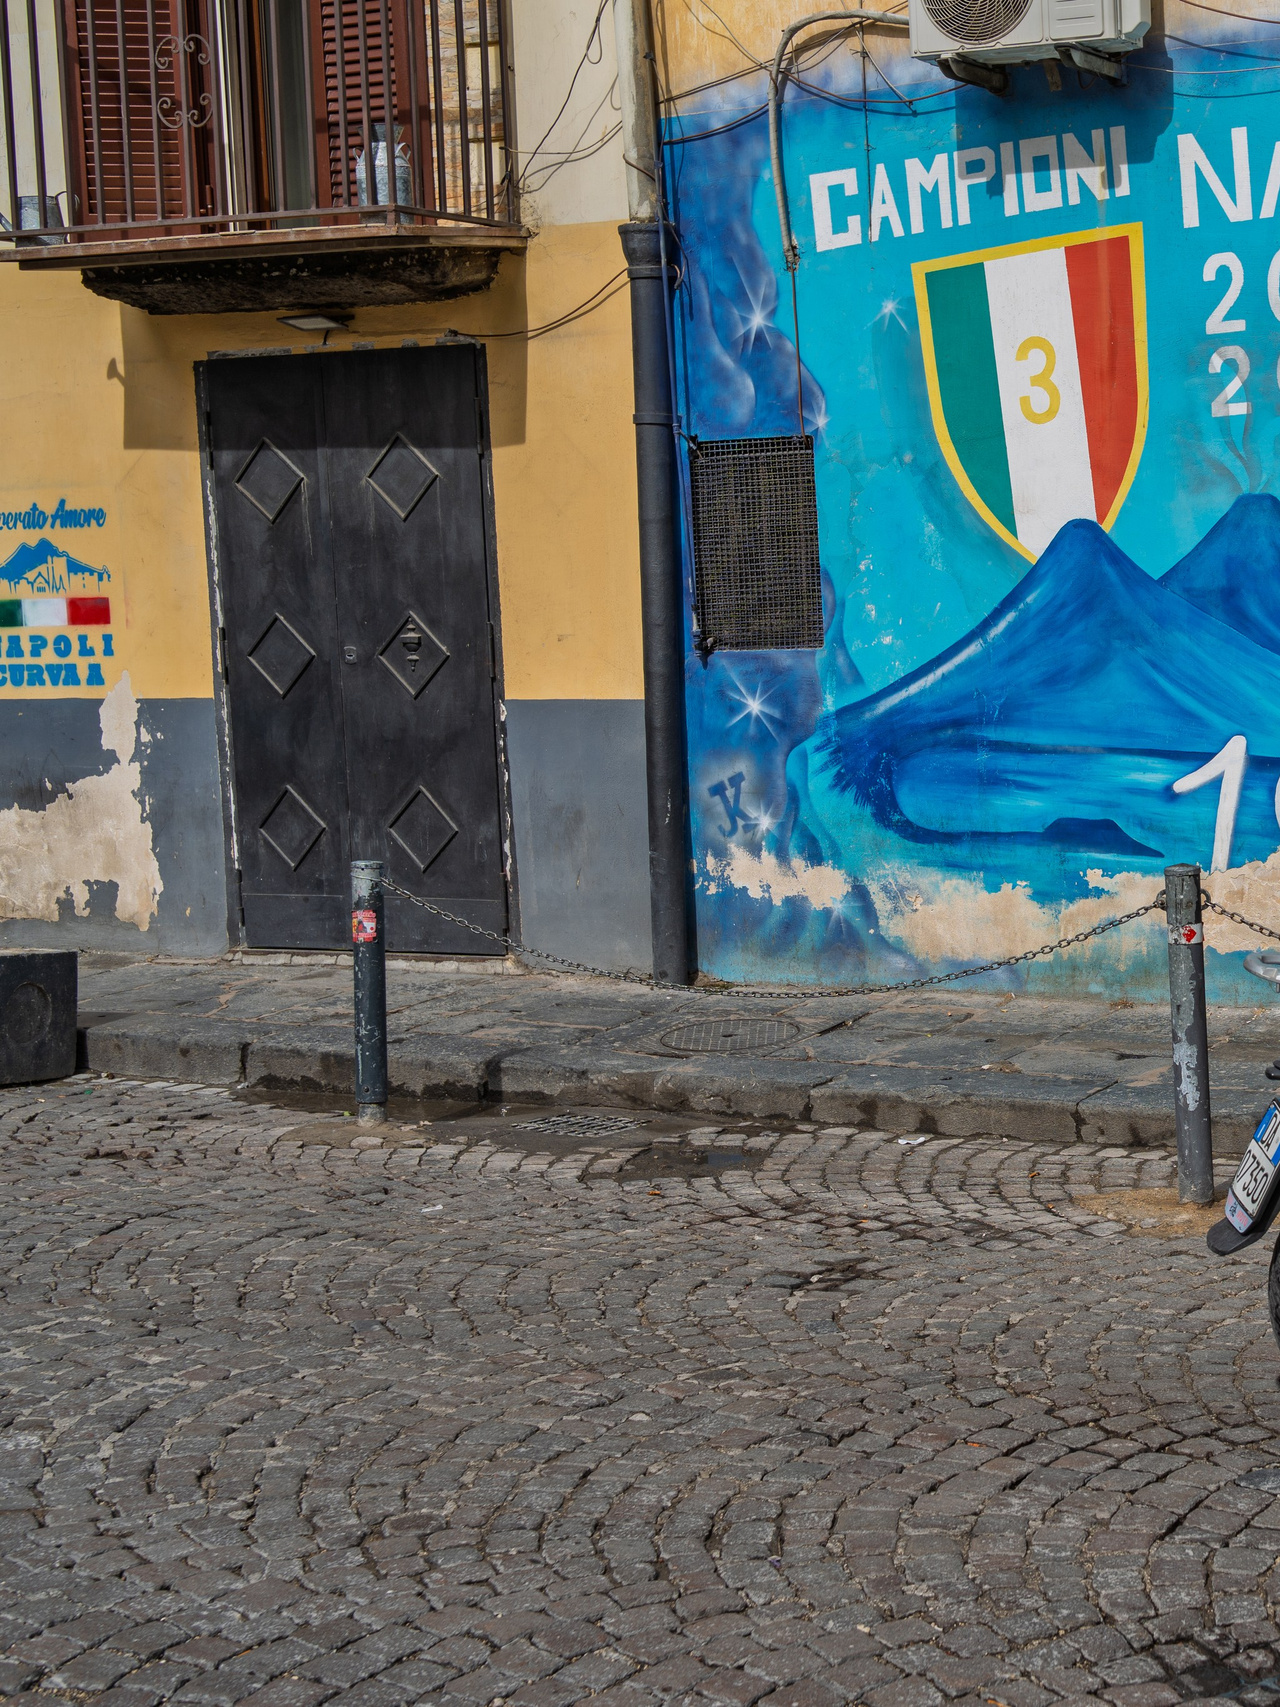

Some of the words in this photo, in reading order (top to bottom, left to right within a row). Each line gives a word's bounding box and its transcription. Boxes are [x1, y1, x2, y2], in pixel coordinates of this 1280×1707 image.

[809, 125, 1131, 253] CAMPIONI
[1015, 336, 1061, 425] 3
[50, 498, 107, 530] Amore
[0, 634, 114, 659] APOLI
[86, 663, 105, 686] A
